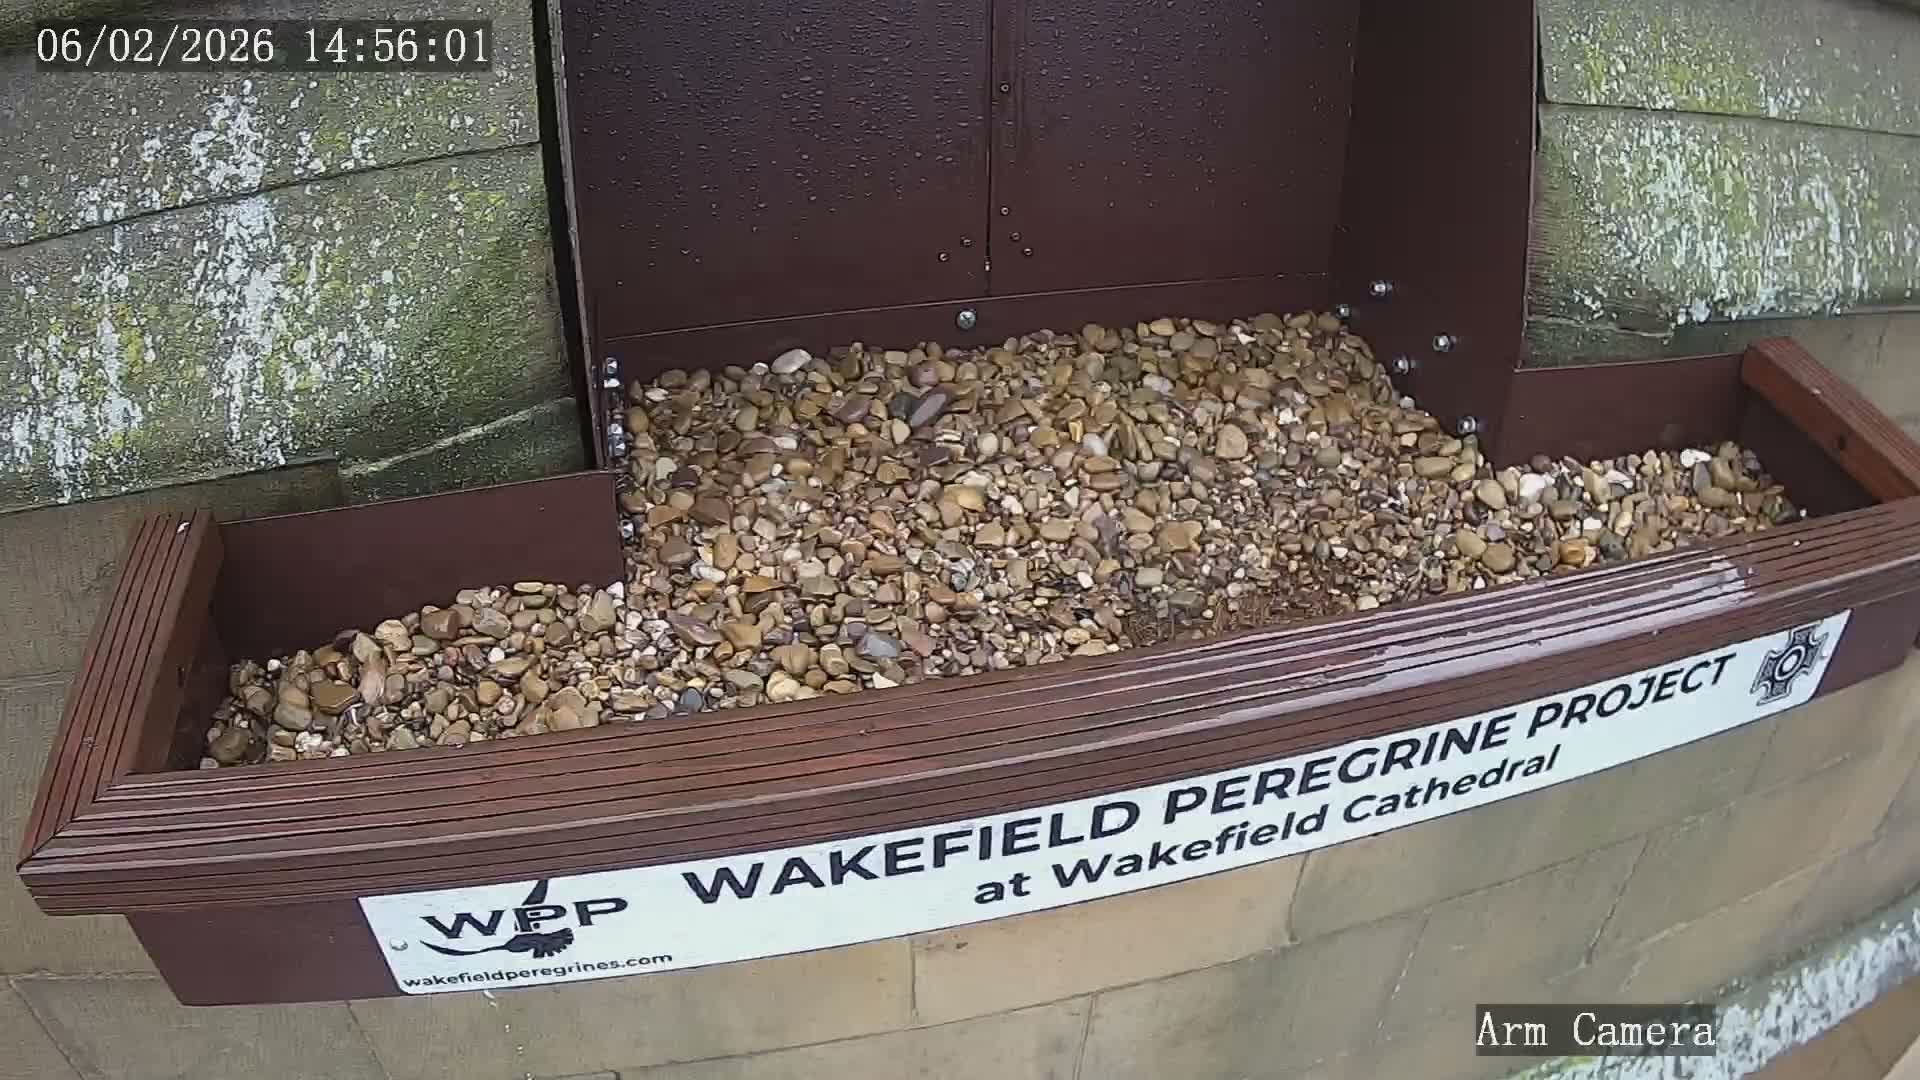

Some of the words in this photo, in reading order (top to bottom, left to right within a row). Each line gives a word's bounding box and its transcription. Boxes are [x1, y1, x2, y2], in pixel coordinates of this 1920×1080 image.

[682, 801, 1141, 905] WAKEFIELD
[1163, 712, 1517, 825] PEREGRINE
[1527, 653, 1737, 738] PROJECT
[974, 872, 1031, 905] at
[1052, 804, 1328, 889] Wakefield
[1342, 744, 1561, 824] Cathedral
[420, 897, 629, 939] WPP
[403, 953, 673, 988] wakefieldperegrines.com
